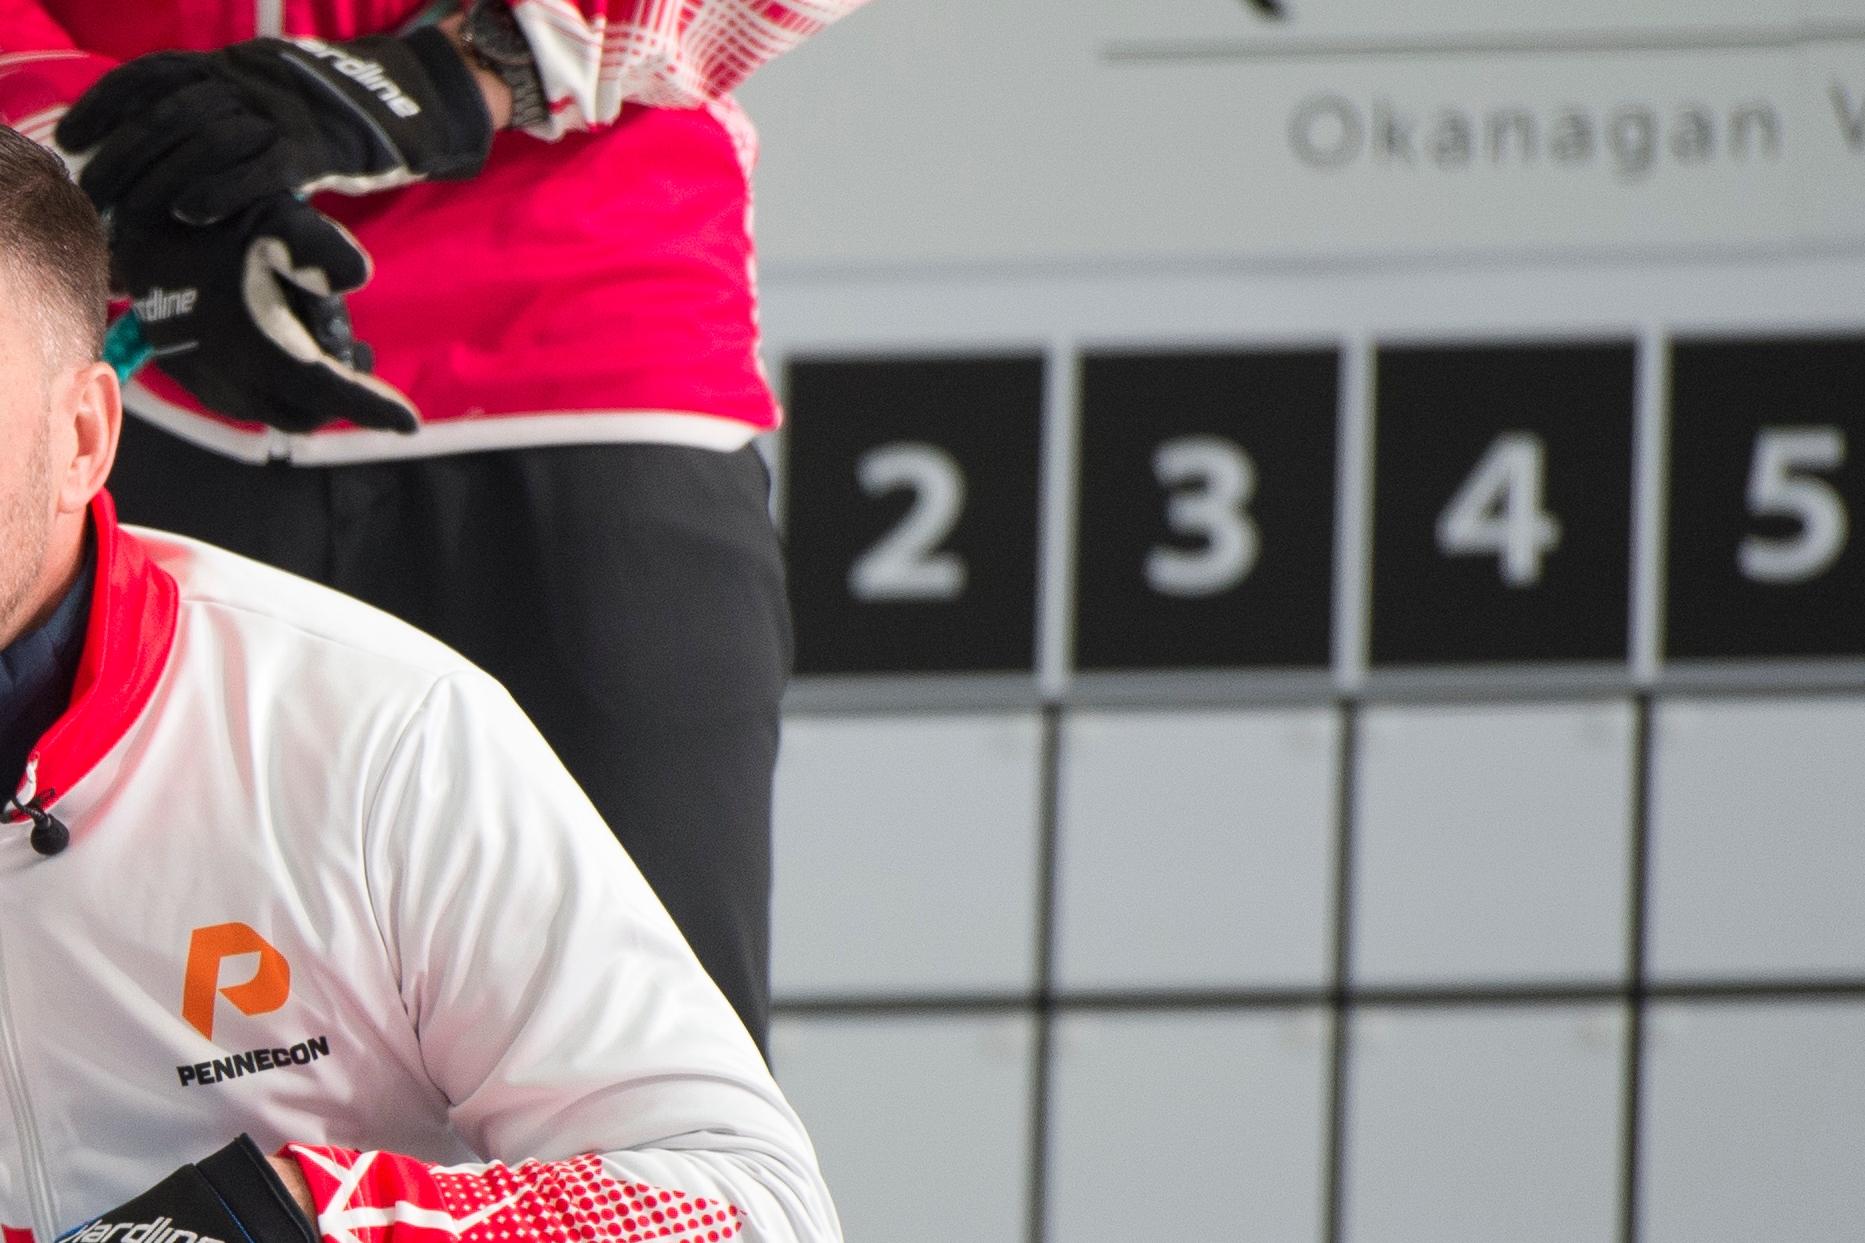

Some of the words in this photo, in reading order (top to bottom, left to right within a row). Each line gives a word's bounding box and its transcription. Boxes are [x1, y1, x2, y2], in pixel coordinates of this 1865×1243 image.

[1286, 90, 1781, 184] Okanagan
[849, 443, 967, 600] 2
[1144, 435, 1260, 595] 3
[1436, 432, 1562, 586] 4
[1737, 426, 1850, 582] 5
[176, 1035, 331, 1087] PENNECON
